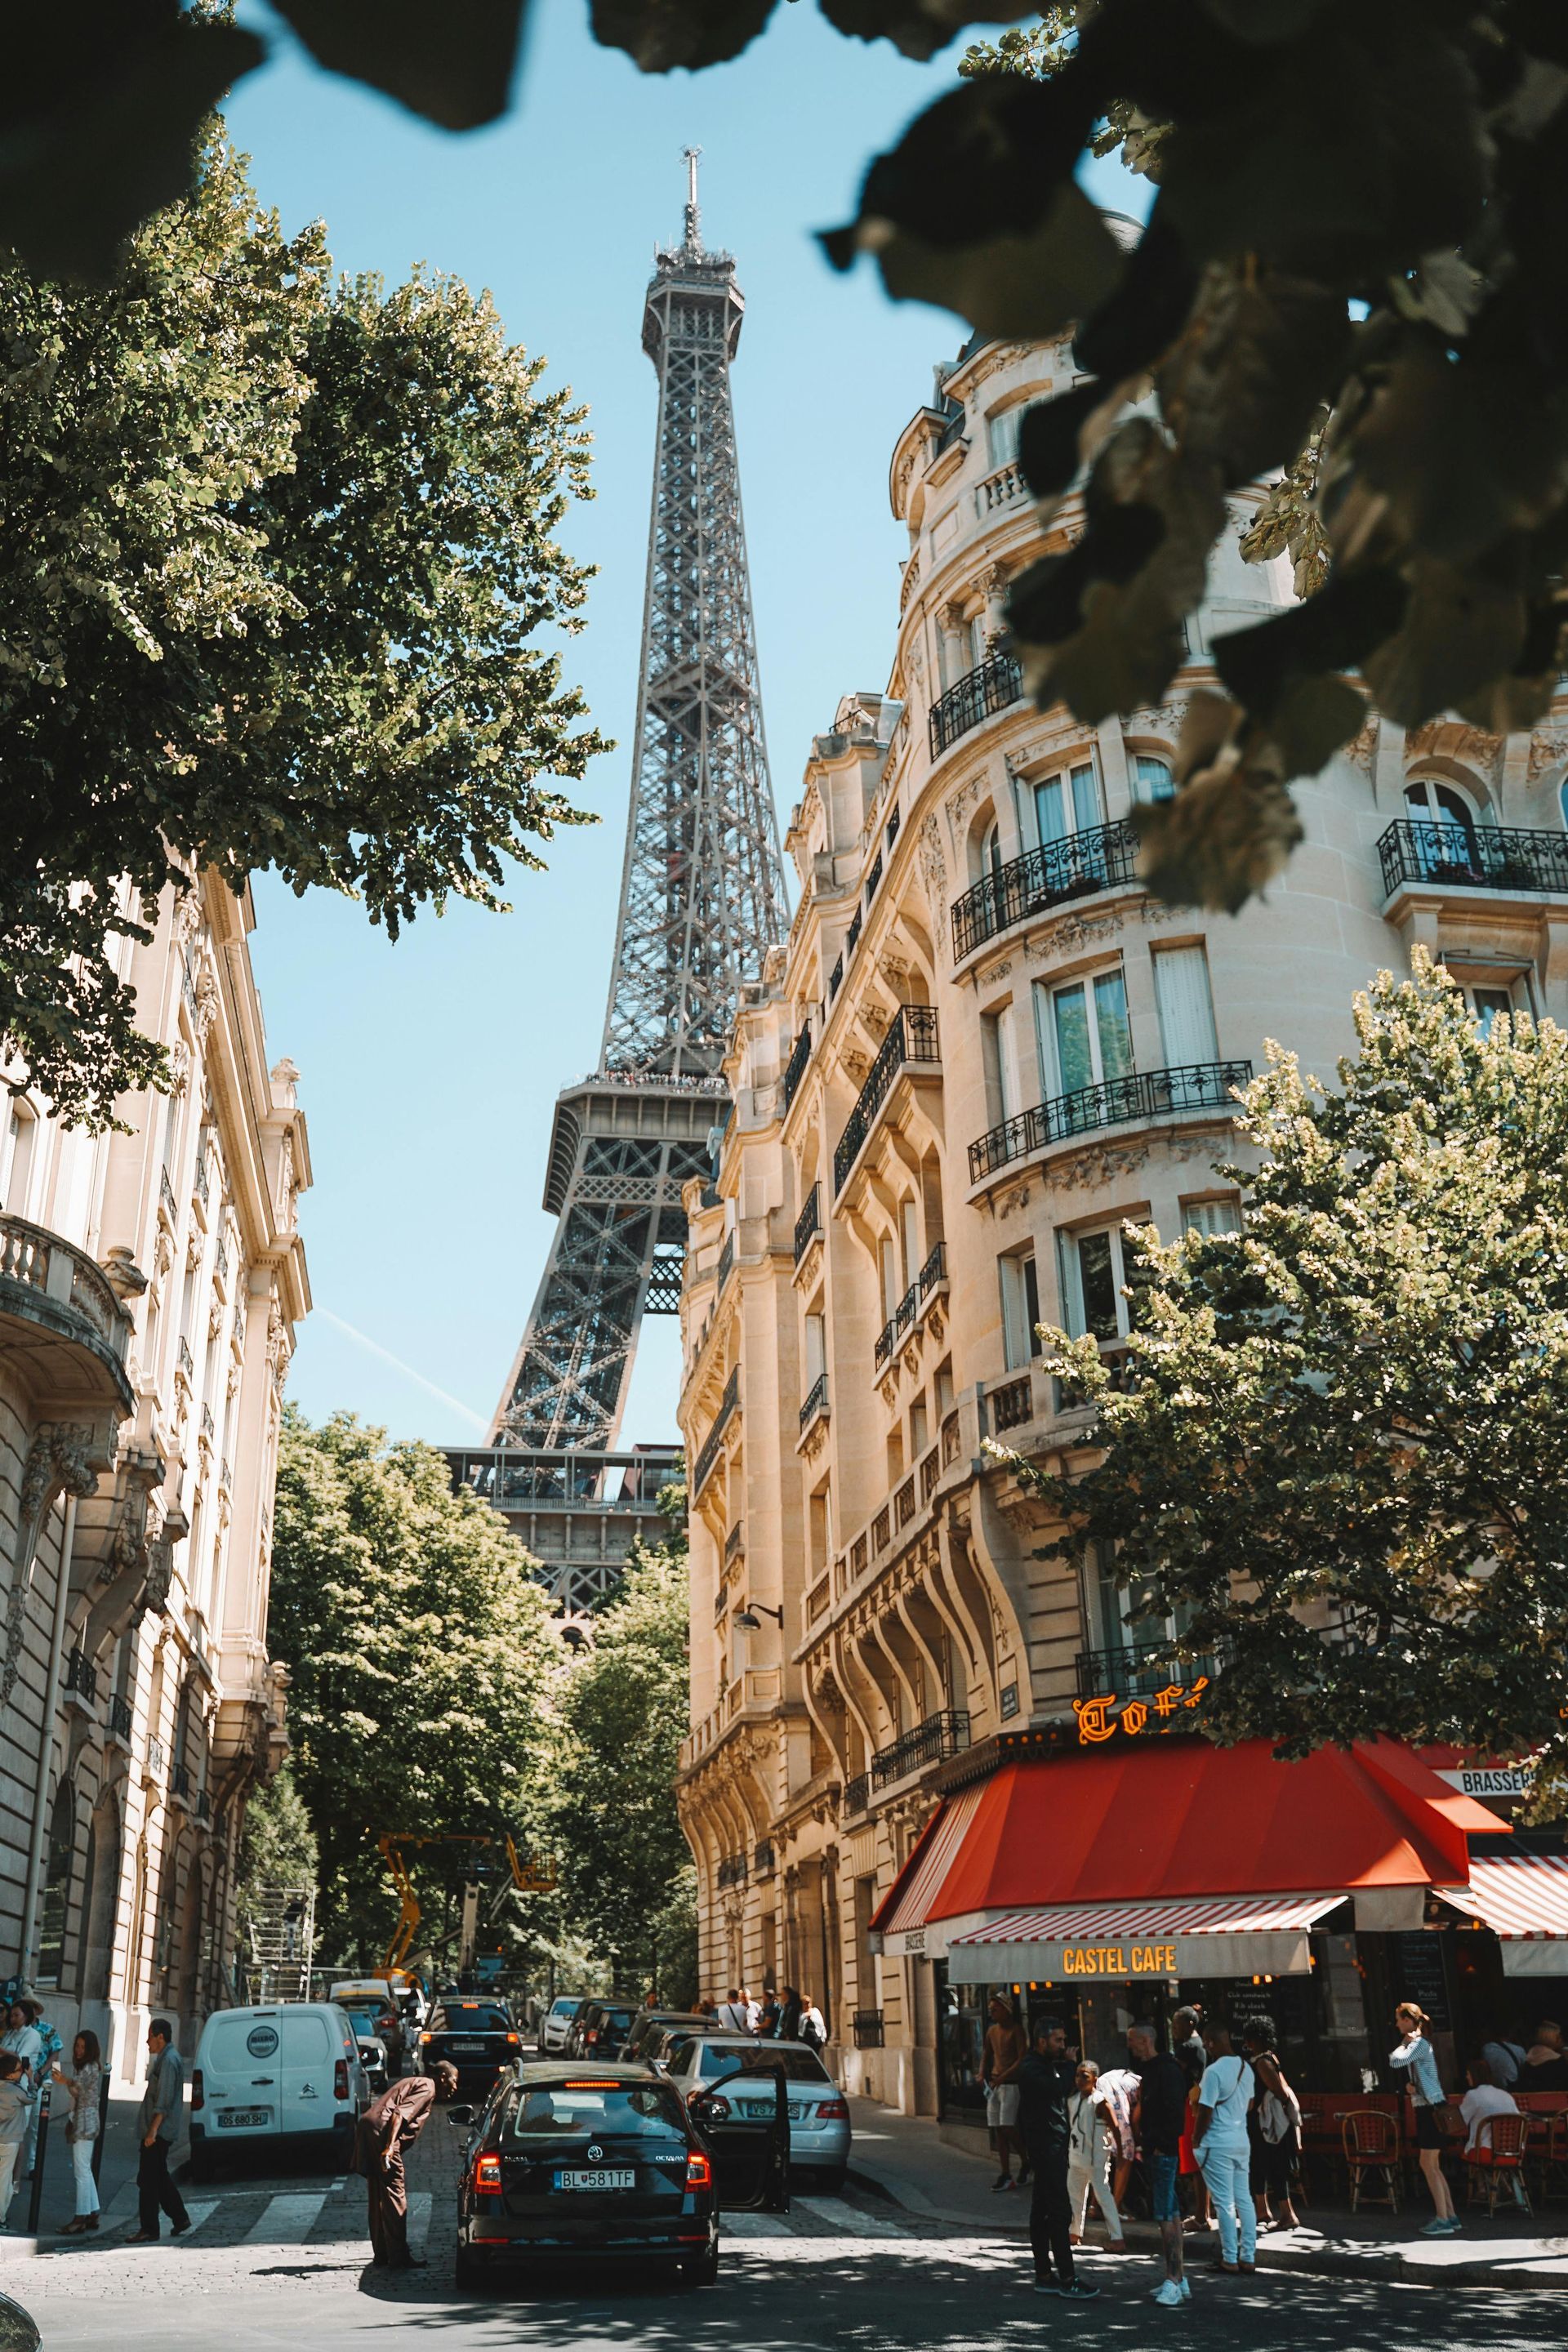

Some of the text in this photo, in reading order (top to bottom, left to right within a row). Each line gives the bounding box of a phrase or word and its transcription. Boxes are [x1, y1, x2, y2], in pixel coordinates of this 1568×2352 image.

[1063, 1945, 1177, 1975] CASTEL CAFE
[235, 2114, 250, 2124] 680
[655, 2154, 685, 2163] OCTAVIA
[562, 2171, 634, 2187] BL 581TF
